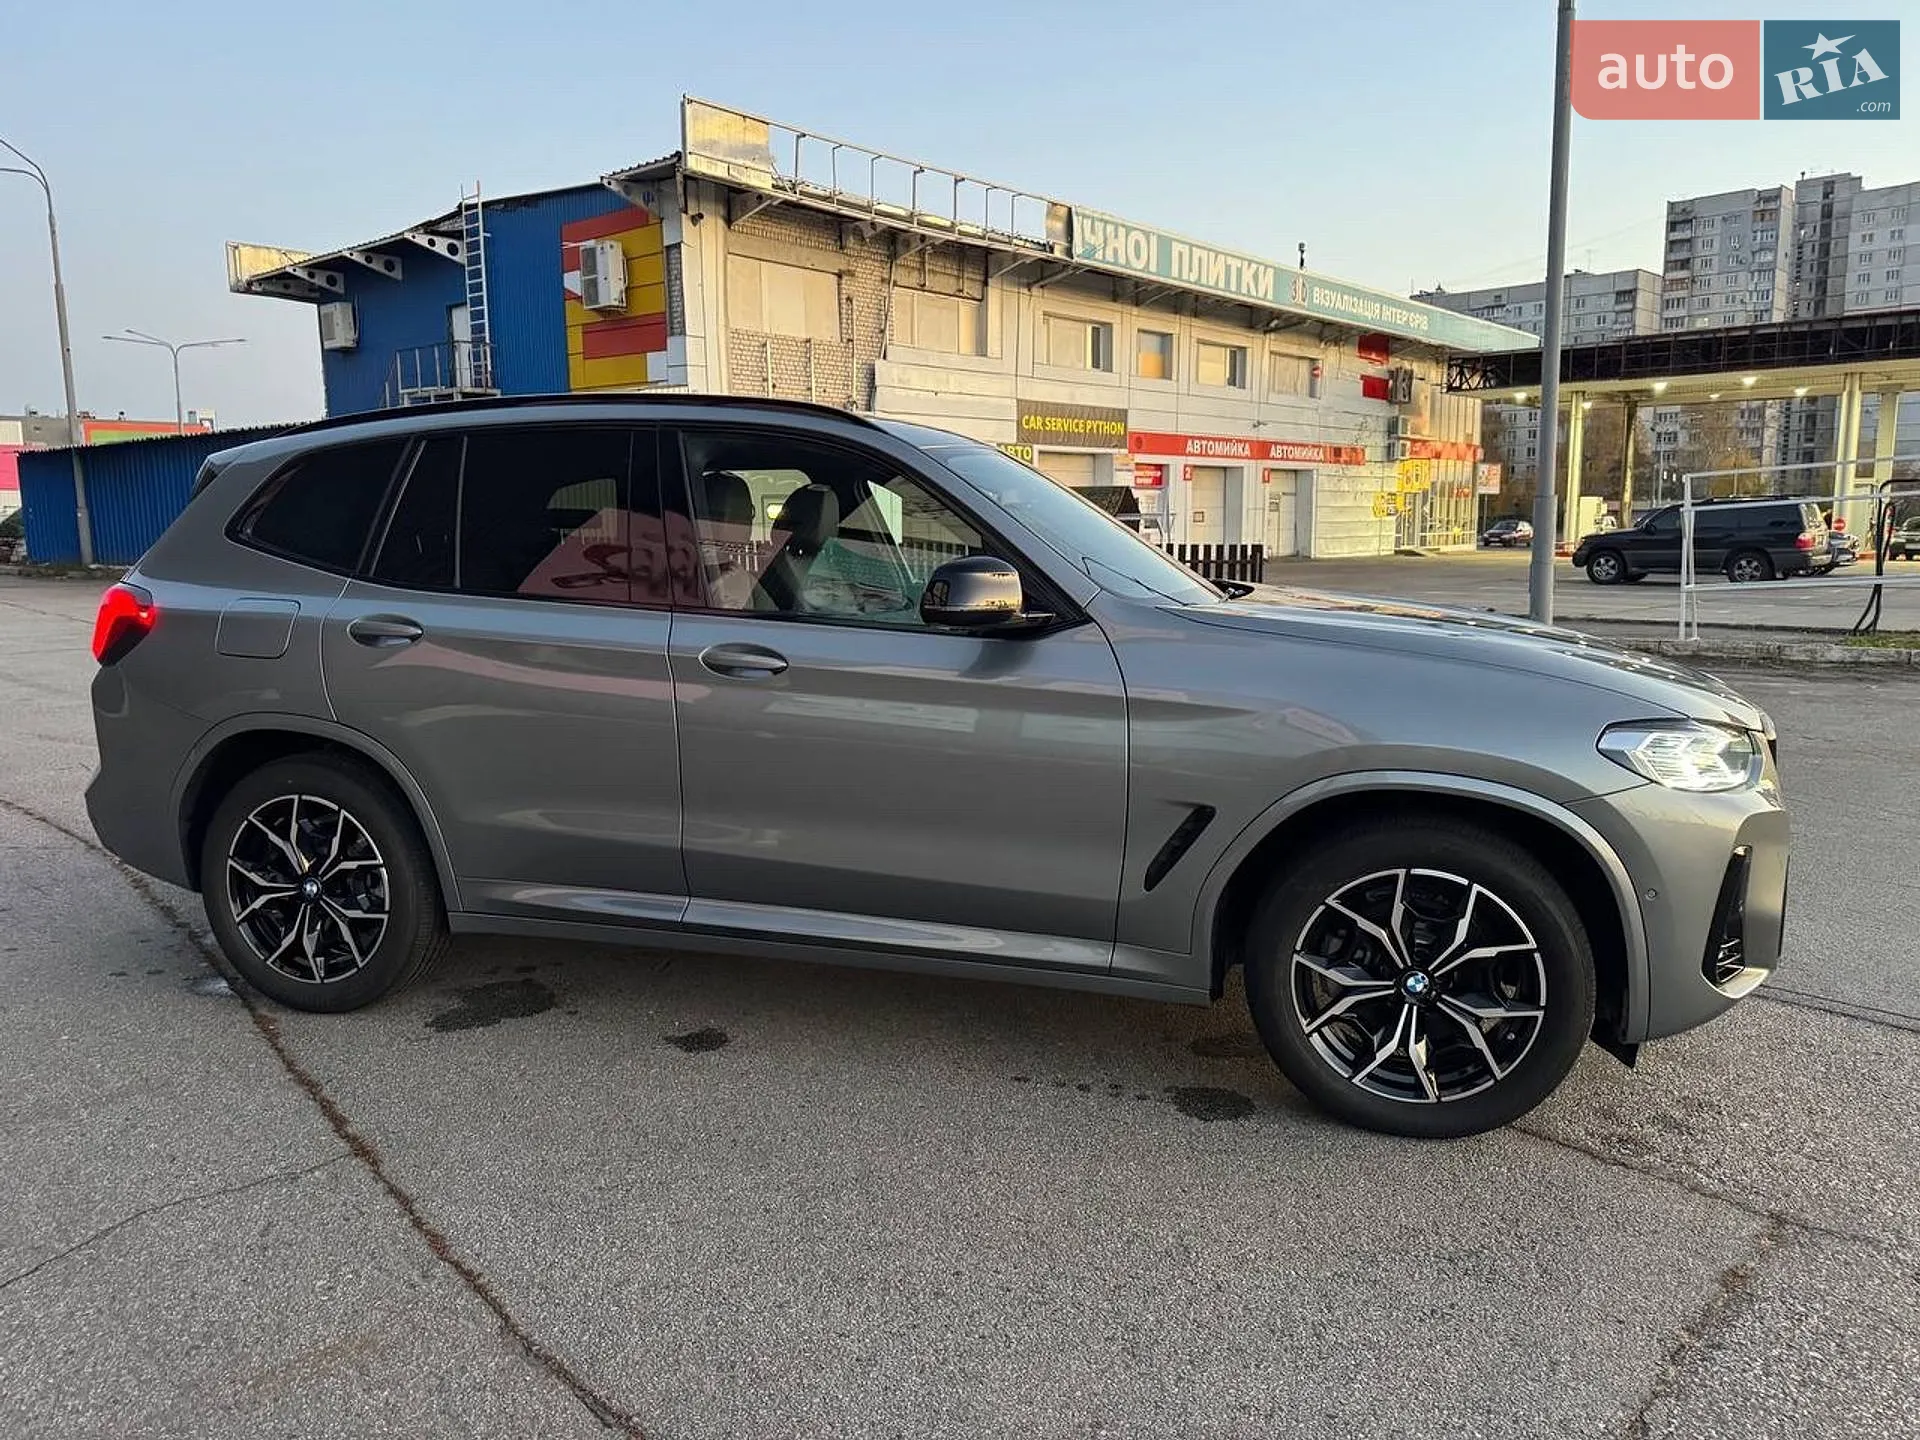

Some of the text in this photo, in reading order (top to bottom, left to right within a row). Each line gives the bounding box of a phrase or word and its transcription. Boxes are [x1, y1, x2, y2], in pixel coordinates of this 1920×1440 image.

[1171, 240, 1274, 299] ПЛИТКИ
[1022, 415, 1124, 435] CAR SERVICE PYTHON
[1185, 440, 1250, 456] АВТОМИЙКА
[1270, 444, 1324, 461] АВТОМИЙКА
[1185, 467, 1191, 479] 2
